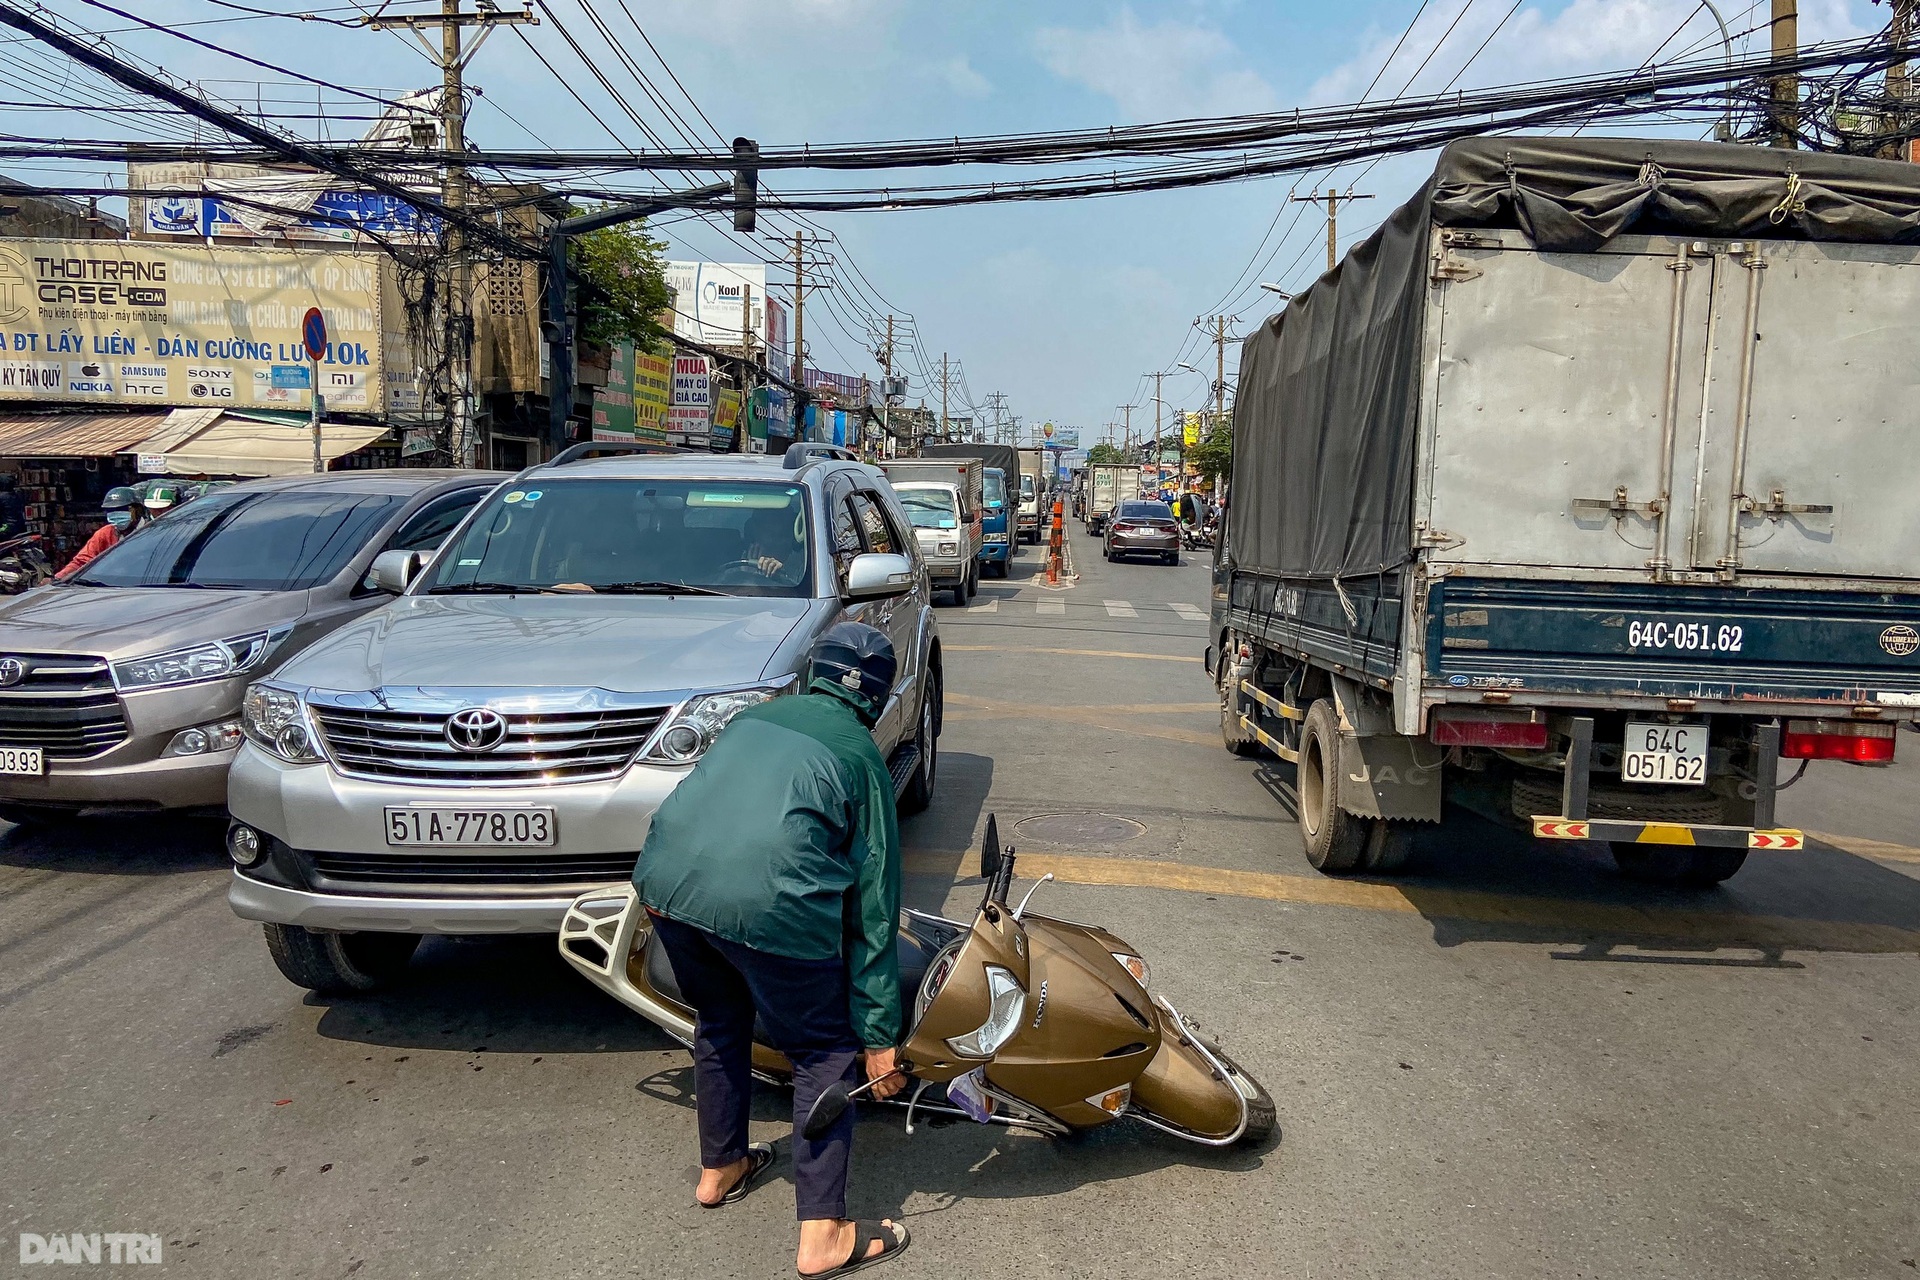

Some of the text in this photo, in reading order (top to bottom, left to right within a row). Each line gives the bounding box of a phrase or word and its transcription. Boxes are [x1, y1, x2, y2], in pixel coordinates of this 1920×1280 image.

[34, 257, 166, 282] THOITRANG
[171, 260, 203, 285] CUNG
[205, 255, 230, 286] CẤP
[245, 267, 256, 288] &
[275, 265, 301, 289] BAO
[38, 284, 118, 305] CASE
[718, 285, 740, 296] Kool
[38, 306, 53, 319] Phụ
[54, 307, 71, 320] kiện
[72, 308, 89, 322] điện
[90, 308, 109, 321] thoại
[115, 310, 131, 323] máy
[171, 299, 197, 325] MUA
[256, 299, 288, 330] CHỮA
[14, 333, 39, 352] ĐT
[46, 327, 84, 354] LẤY
[94, 329, 136, 356] LIỀN
[157, 334, 199, 358] DÁN
[205, 336, 272, 361] CƯỜNG
[323, 342, 370, 366] 10k
[3, 363, 61, 390] KỲ TÂN QUÝ
[121, 366, 167, 377] SAMSUNG
[188, 369, 233, 379] SONY
[676, 359, 707, 374] MUA
[70, 382, 113, 393] NOKIA
[211, 386, 232, 398] LG
[676, 376, 694, 389] MÁY
[696, 377, 708, 389] CŨ
[675, 390, 690, 403] GIÁ
[691, 392, 708, 403] CAO
[1628, 620, 1743, 652] 64C-051.62
[1645, 729, 1688, 753] 64C
[1349, 764, 1430, 786] JAC
[1626, 755, 1703, 782] 051.62
[391, 811, 548, 843] 51A-778.03
[1032, 979, 1048, 1029] HONDA
